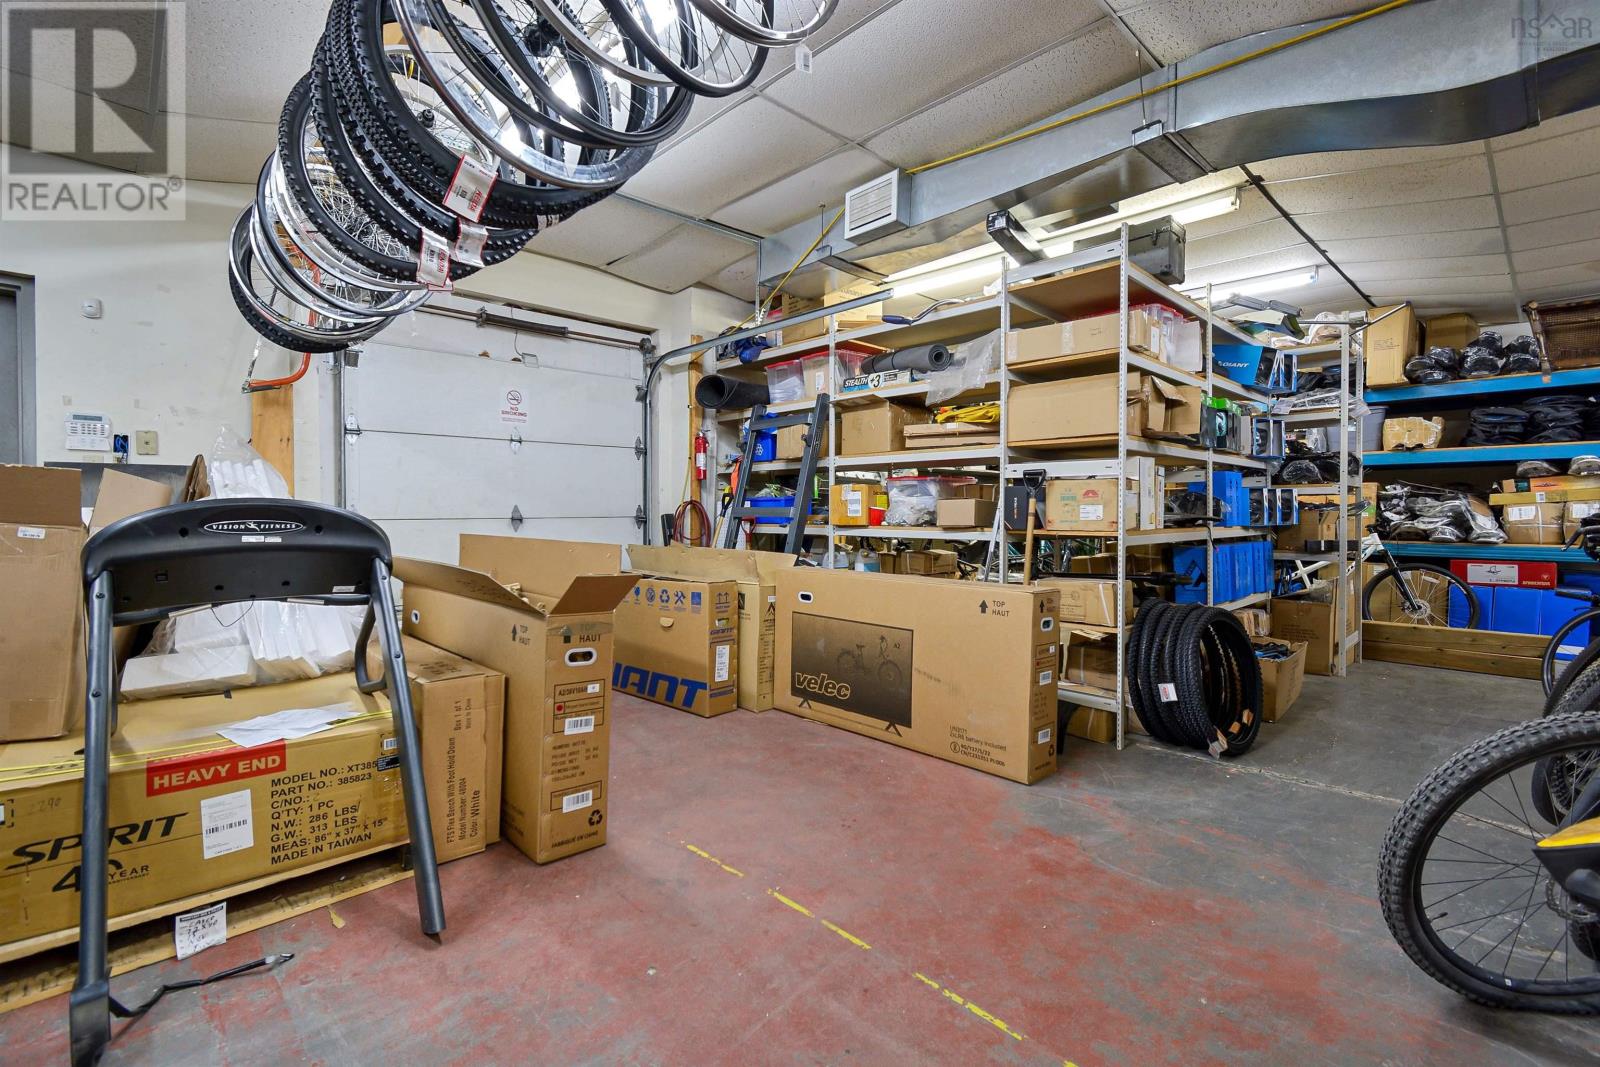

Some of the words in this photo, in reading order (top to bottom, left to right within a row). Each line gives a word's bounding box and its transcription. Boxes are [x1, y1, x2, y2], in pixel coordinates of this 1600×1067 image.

[844, 377, 868, 388] STEALTH
[260, 522, 297, 530] FITNESS
[991, 609, 1010, 617] HAUT
[992, 600, 1006, 608] TOP
[612, 662, 708, 710] IANT
[795, 672, 850, 700] velec
[152, 763, 231, 790] HEAVY
[237, 755, 281, 775] END
[271, 772, 317, 788] MODEL
[319, 767, 345, 778] NO.:
[271, 784, 305, 799] PART
[307, 780, 333, 792] NO.:
[337, 773, 373, 786] 385823
[270, 795, 310, 810] C/NO.:
[271, 806, 304, 820] Q'TY:
[317, 800, 334, 811] PC
[470, 789, 480, 818] White
[270, 829, 303, 844] G.W.:
[309, 822, 328, 834] 313
[334, 815, 358, 828] LBS
[271, 818, 303, 833] N.W.:
[308, 812, 329, 824] 286
[5, 812, 190, 871] SPRIT
[271, 838, 311, 854] MEAS:
[271, 848, 308, 865] MADE
[311, 844, 324, 854] IN
[327, 831, 372, 850] TAIWAN
[108, 864, 150, 881] YEAR
